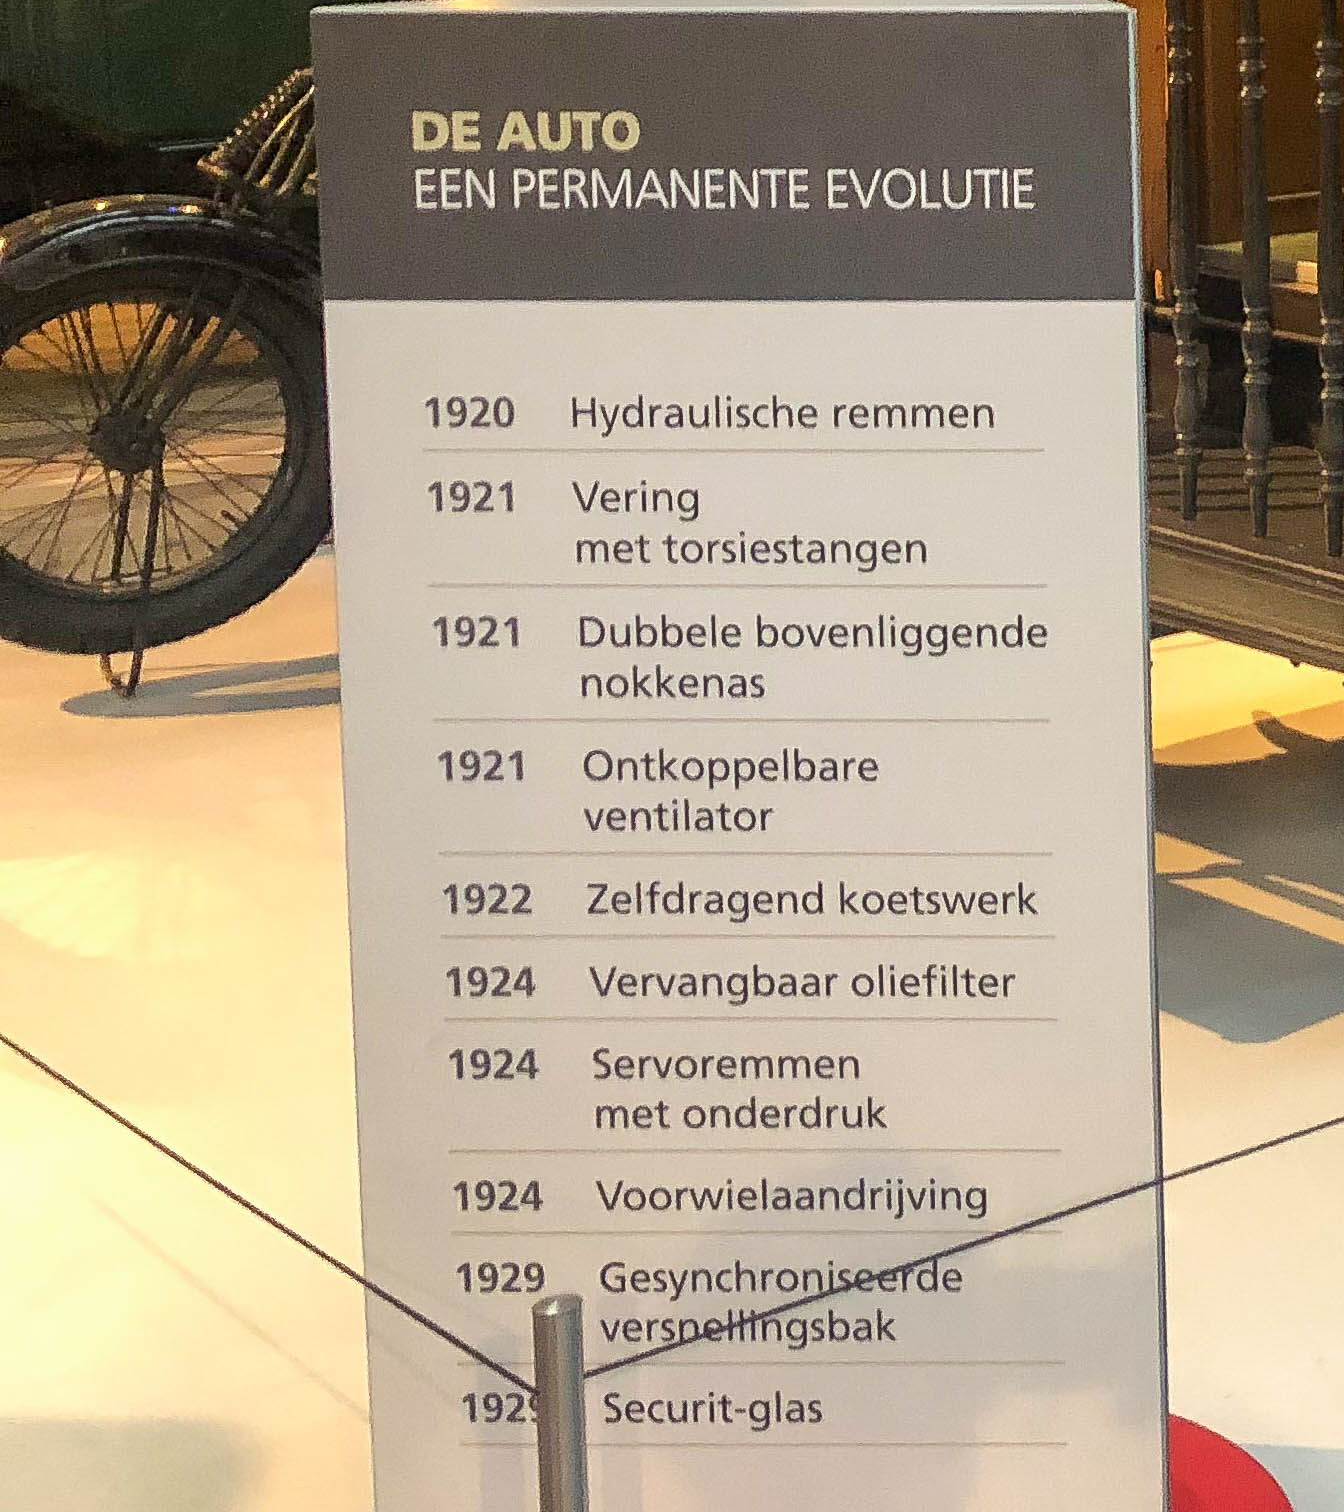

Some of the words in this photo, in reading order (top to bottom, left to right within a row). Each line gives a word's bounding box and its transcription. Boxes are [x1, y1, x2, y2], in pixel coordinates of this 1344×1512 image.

[411, 110, 481, 152] DE
[497, 109, 641, 152] AUTO
[413, 166, 496, 210] EEN
[512, 166, 809, 210] PERMANENTE
[826, 166, 1036, 210] EVOLUTIE
[424, 395, 515, 429] 1920
[571, 393, 819, 440] Hydraulische
[833, 403, 996, 430] remmen
[427, 479, 515, 514] 1921
[572, 479, 700, 523] Vering
[575, 534, 651, 565] met
[661, 530, 928, 571] torsiestangen
[432, 615, 520, 648] 1921
[579, 613, 742, 649] Dubbele
[756, 613, 1049, 659] bovenliggende
[580, 662, 766, 699] nokkenas
[437, 749, 525, 782] 1921
[583, 746, 880, 791] Ontkoppelbare
[583, 797, 775, 833] ventilator
[442, 881, 533, 917] 1922
[586, 880, 825, 924] Zelfdragend
[839, 880, 1039, 916] koetswerk
[446, 965, 537, 999] 1924
[588, 963, 839, 1007] Vervangbaar
[850, 963, 1016, 999] oliefilter
[448, 1047, 540, 1081] 1924
[592, 1046, 861, 1081] Servoremmen
[595, 1099, 671, 1130] met
[683, 1095, 888, 1130] onderdruk
[453, 1179, 544, 1212] 1924
[595, 1177, 988, 1220] Voorwielaandrijving
[456, 1261, 545, 1293] 1929
[599, 1259, 964, 1302] Gesynchroniseerde
[603, 1389, 823, 1432] Securit-glas
